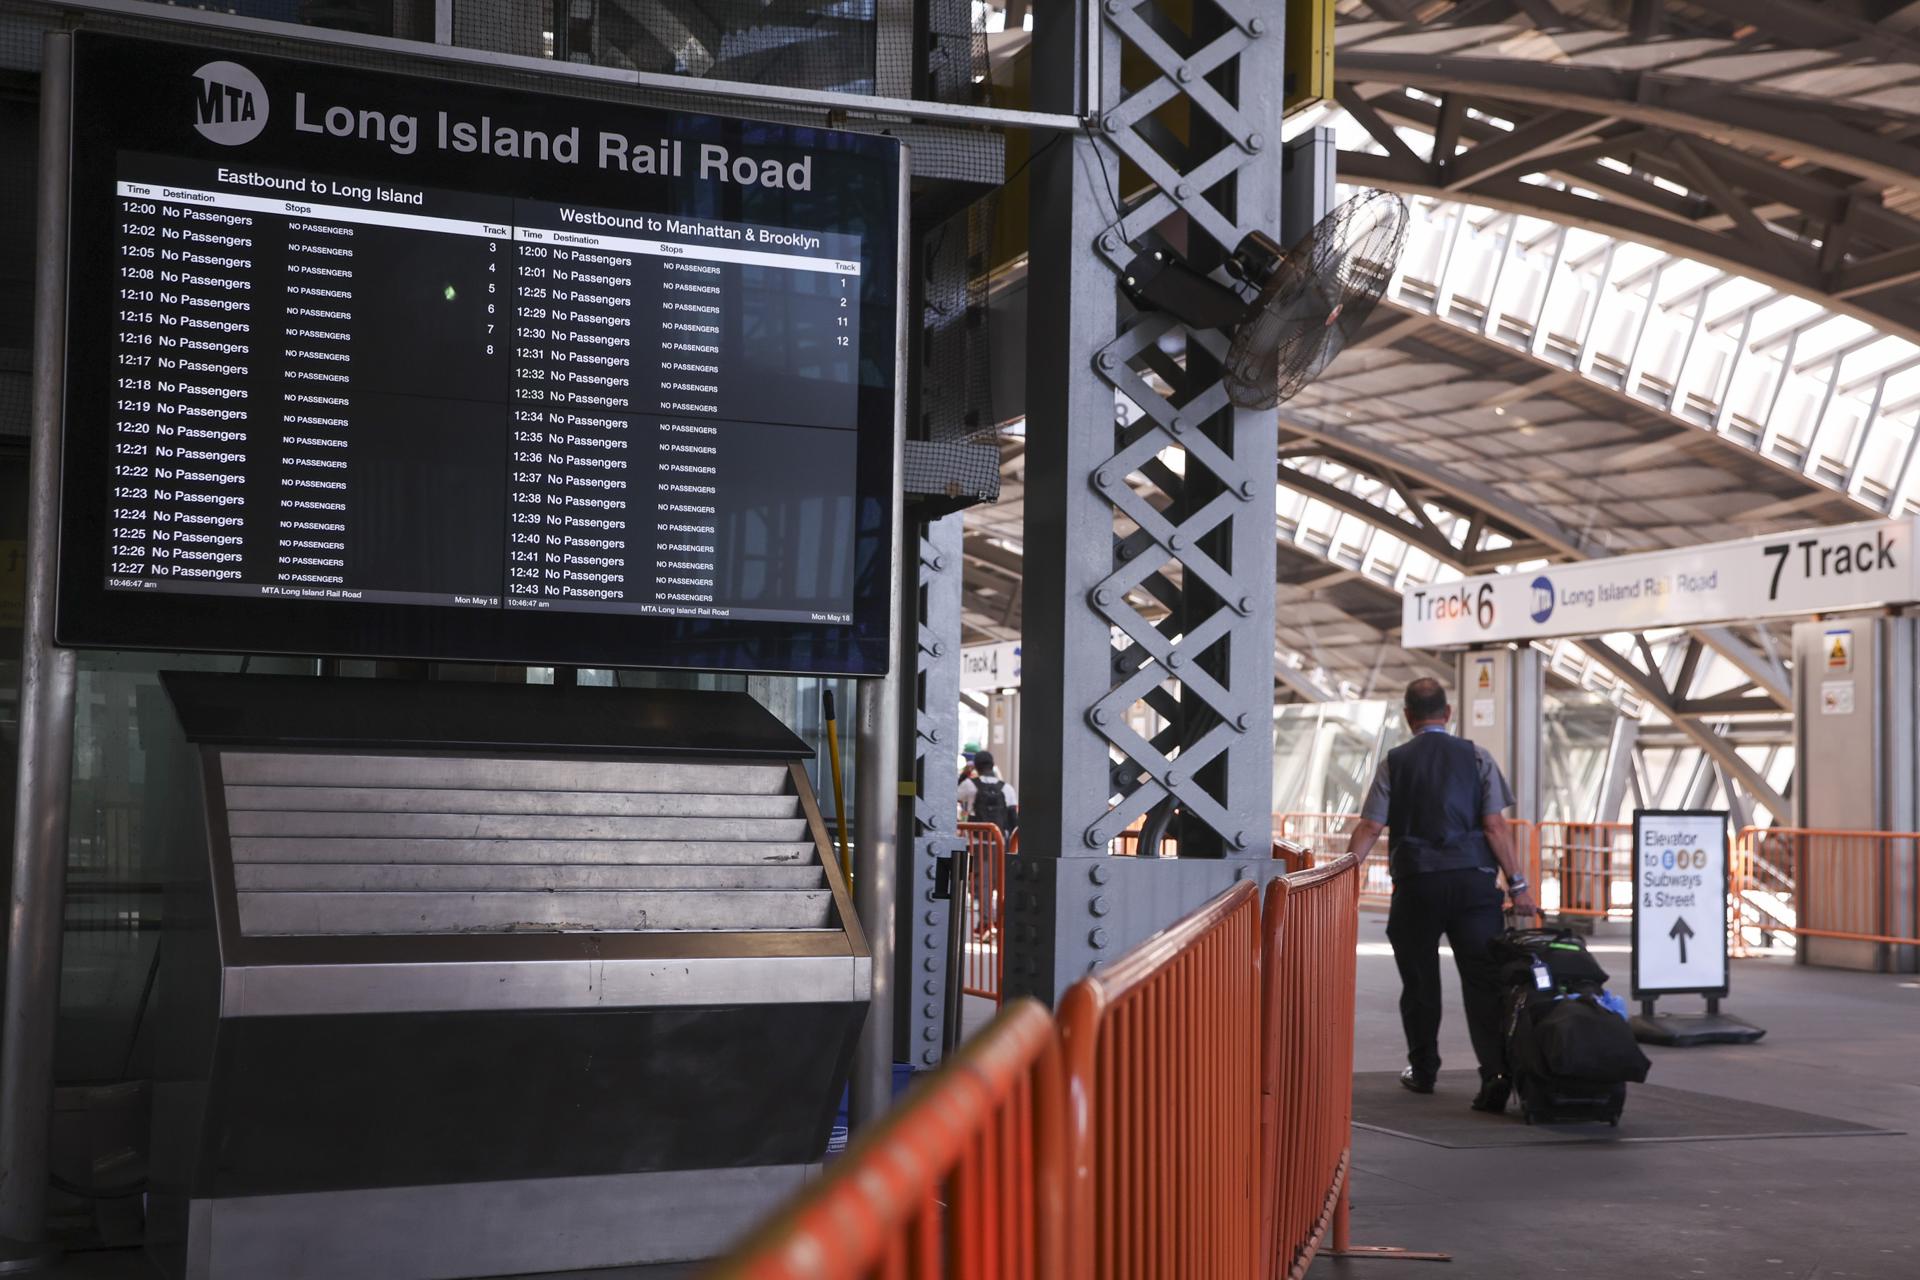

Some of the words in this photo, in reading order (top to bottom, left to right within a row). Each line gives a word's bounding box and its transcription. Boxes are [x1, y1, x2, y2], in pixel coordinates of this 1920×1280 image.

[192, 76, 256, 125] MTA
[295, 92, 418, 155] Long
[438, 111, 579, 164] Island
[598, 131, 682, 177] Rail
[700, 143, 812, 192] Road
[218, 168, 305, 191] Eastbound
[310, 180, 326, 193] to
[332, 182, 371, 202] Long
[376, 187, 422, 204] Island
[123, 202, 155, 214] 12:00
[162, 206, 180, 217] No
[183, 208, 252, 225] Passengers
[302, 224, 353, 236] PASSENGERS
[489, 242, 496, 252] 3
[127, 184, 150, 194] Time
[163, 188, 214, 202] Destination
[285, 202, 311, 214] Stops
[483, 225, 506, 235] Track
[122, 223, 155, 236] 12:02
[162, 227, 179, 238] No
[183, 229, 252, 247] Passengers
[301, 245, 353, 256] PASSENGERS
[488, 263, 495, 272] 4
[560, 208, 643, 229] Westbound
[647, 218, 662, 231] to
[666, 219, 741, 240] Manhattan
[745, 228, 755, 241] &
[759, 229, 819, 250] Brooklyn
[519, 246, 547, 257] 12:00
[553, 249, 568, 259] No
[571, 250, 631, 266] Passengers
[675, 263, 720, 274] PASSENGERS
[841, 278, 845, 287] 1
[522, 229, 542, 238] Time
[553, 233, 599, 244] Destination
[660, 244, 683, 254] Stops
[835, 262, 855, 271] Track
[121, 245, 154, 258] 12:05
[161, 249, 178, 260] No
[182, 251, 251, 268] Passengers
[301, 266, 352, 278] PASSENGERS
[488, 283, 495, 293] 5
[518, 266, 545, 277] 12:01
[553, 269, 568, 280] No
[571, 271, 631, 286] Passengers
[675, 283, 720, 294] PASSENGERS
[840, 297, 846, 306] 2
[121, 267, 153, 279] 12:08
[161, 270, 178, 282] No
[182, 273, 251, 289] Passengers
[300, 287, 352, 298] PASSENGERS
[488, 303, 494, 313] 6
[518, 286, 546, 298] 12:25
[552, 289, 567, 300] No
[570, 291, 630, 306] Passengers
[674, 303, 719, 313] PASSENGERS
[838, 317, 847, 326] 11
[120, 288, 153, 301] 12:10
[160, 292, 177, 303] No
[181, 294, 250, 311] Passengers
[300, 308, 351, 319] PASSENGERS
[487, 324, 494, 333] 7
[517, 307, 546, 318] 12:29
[552, 310, 567, 320] No
[570, 311, 630, 326] Passengers
[674, 323, 719, 333] PASSENGERS
[837, 336, 848, 346] 12
[120, 310, 152, 323] 12:15
[159, 314, 176, 325] No
[180, 316, 249, 332] Passengers
[299, 329, 350, 340] PASSENGERS
[486, 344, 493, 354] 8
[516, 388, 544, 399] 12:33
[550, 391, 565, 401] No
[568, 392, 628, 407] Passengers
[672, 402, 717, 412] PASSENGERS
[116, 443, 146, 455] 12:21
[156, 446, 173, 456] No
[176, 447, 246, 463] Passengers
[296, 458, 347, 468] PASSENGERS
[513, 472, 541, 482] 12:37
[548, 474, 563, 484] No
[566, 475, 626, 489] Passengers
[670, 484, 715, 493] PASSENGERS
[511, 533, 540, 543] 12:40
[546, 534, 561, 544] No
[564, 535, 625, 549] Passengers
[111, 562, 144, 573] 12:27
[151, 564, 168, 575] No
[172, 565, 242, 580] Passengers
[291, 574, 343, 583] PASSENGERS
[1764, 544, 1790, 600] 7
[1798, 531, 1896, 578] Track
[281, 587, 300, 596] Long
[472, 597, 487, 605] May
[510, 583, 538, 594] 12:43
[544, 585, 560, 595] No
[563, 586, 623, 599] Passengers
[667, 593, 712, 601] PASSENGERS
[1414, 586, 1471, 621] Track
[1478, 584, 1494, 630] 6
[1560, 589, 1594, 607] Long
[1598, 580, 1640, 601] Island
[1677, 570, 1718, 593] Road
[658, 606, 675, 614] Long
[827, 614, 840, 622] May
[964, 651, 988, 673] Track
[990, 650, 998, 680] 4
[1645, 830, 1698, 846] Elevator
[1645, 853, 1658, 866] to
[1644, 872, 1702, 889] Subways
[1644, 893, 1652, 908] &
[1656, 892, 1696, 908] Street
